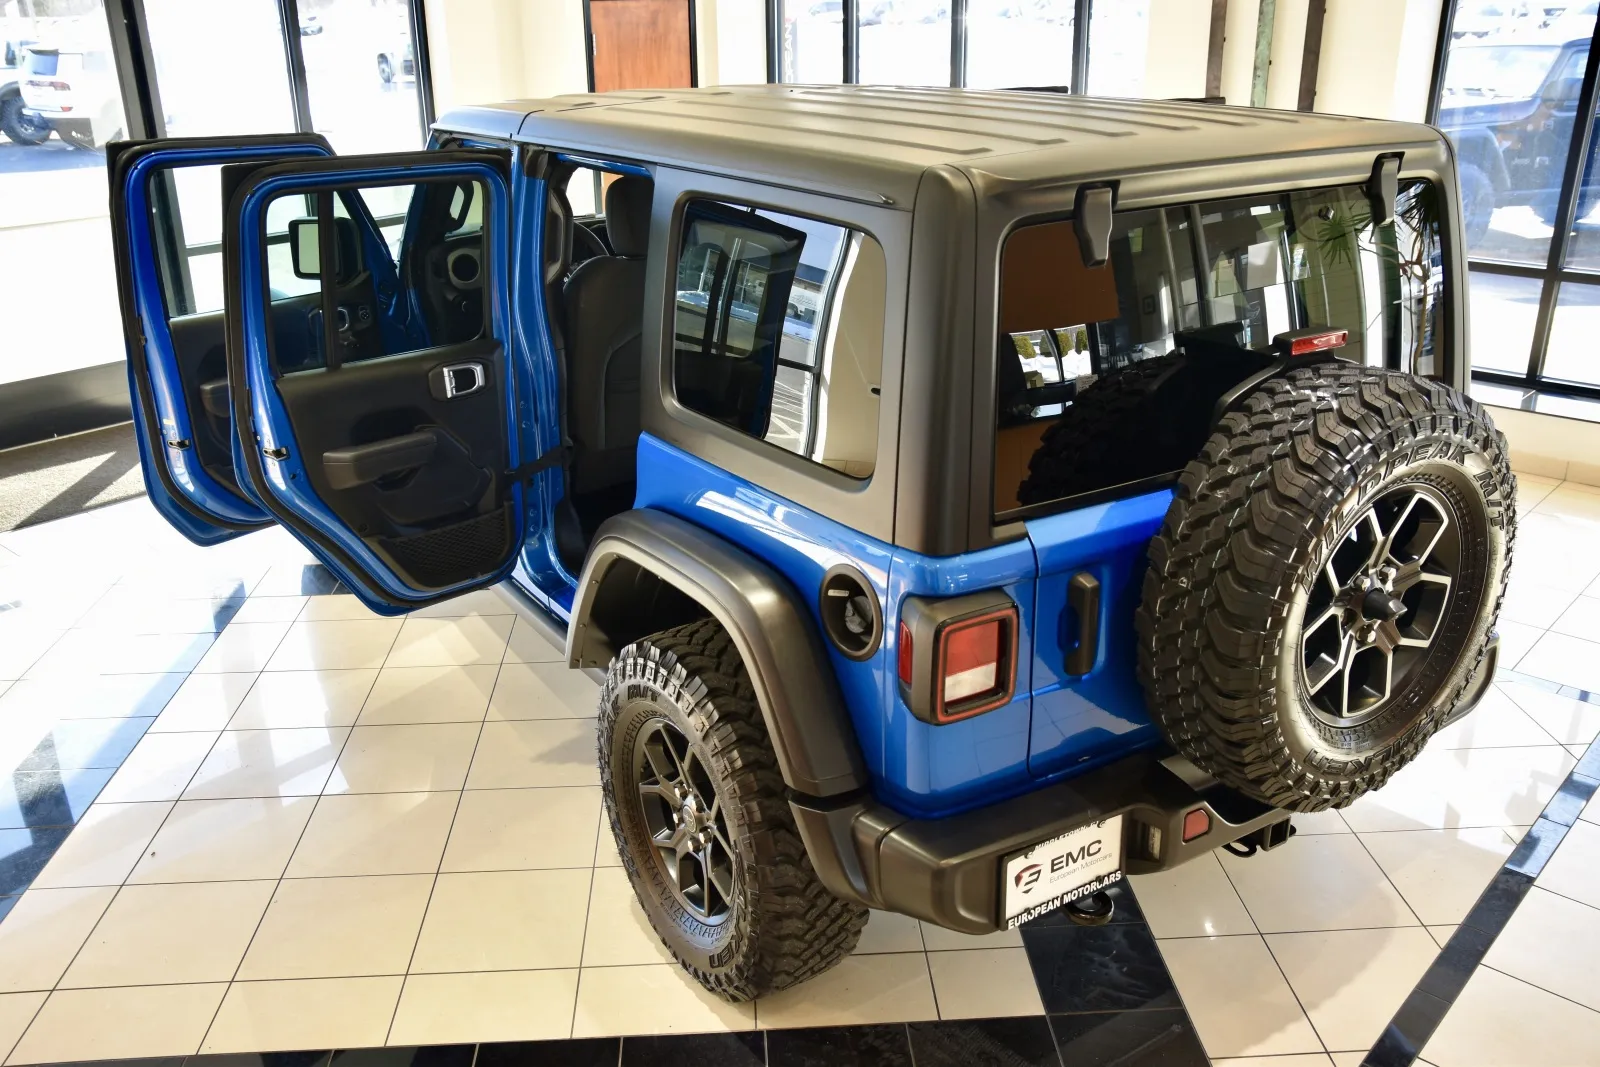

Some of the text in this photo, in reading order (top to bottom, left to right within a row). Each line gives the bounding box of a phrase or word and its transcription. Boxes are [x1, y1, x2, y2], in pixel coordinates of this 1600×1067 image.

[1301, 440, 1467, 596] WILDPEAK
[1049, 852, 1112, 883] European Motorcars
[1050, 839, 1102, 873] EMC
[1007, 870, 1122, 930] EUROPEAN MOTORCARS
